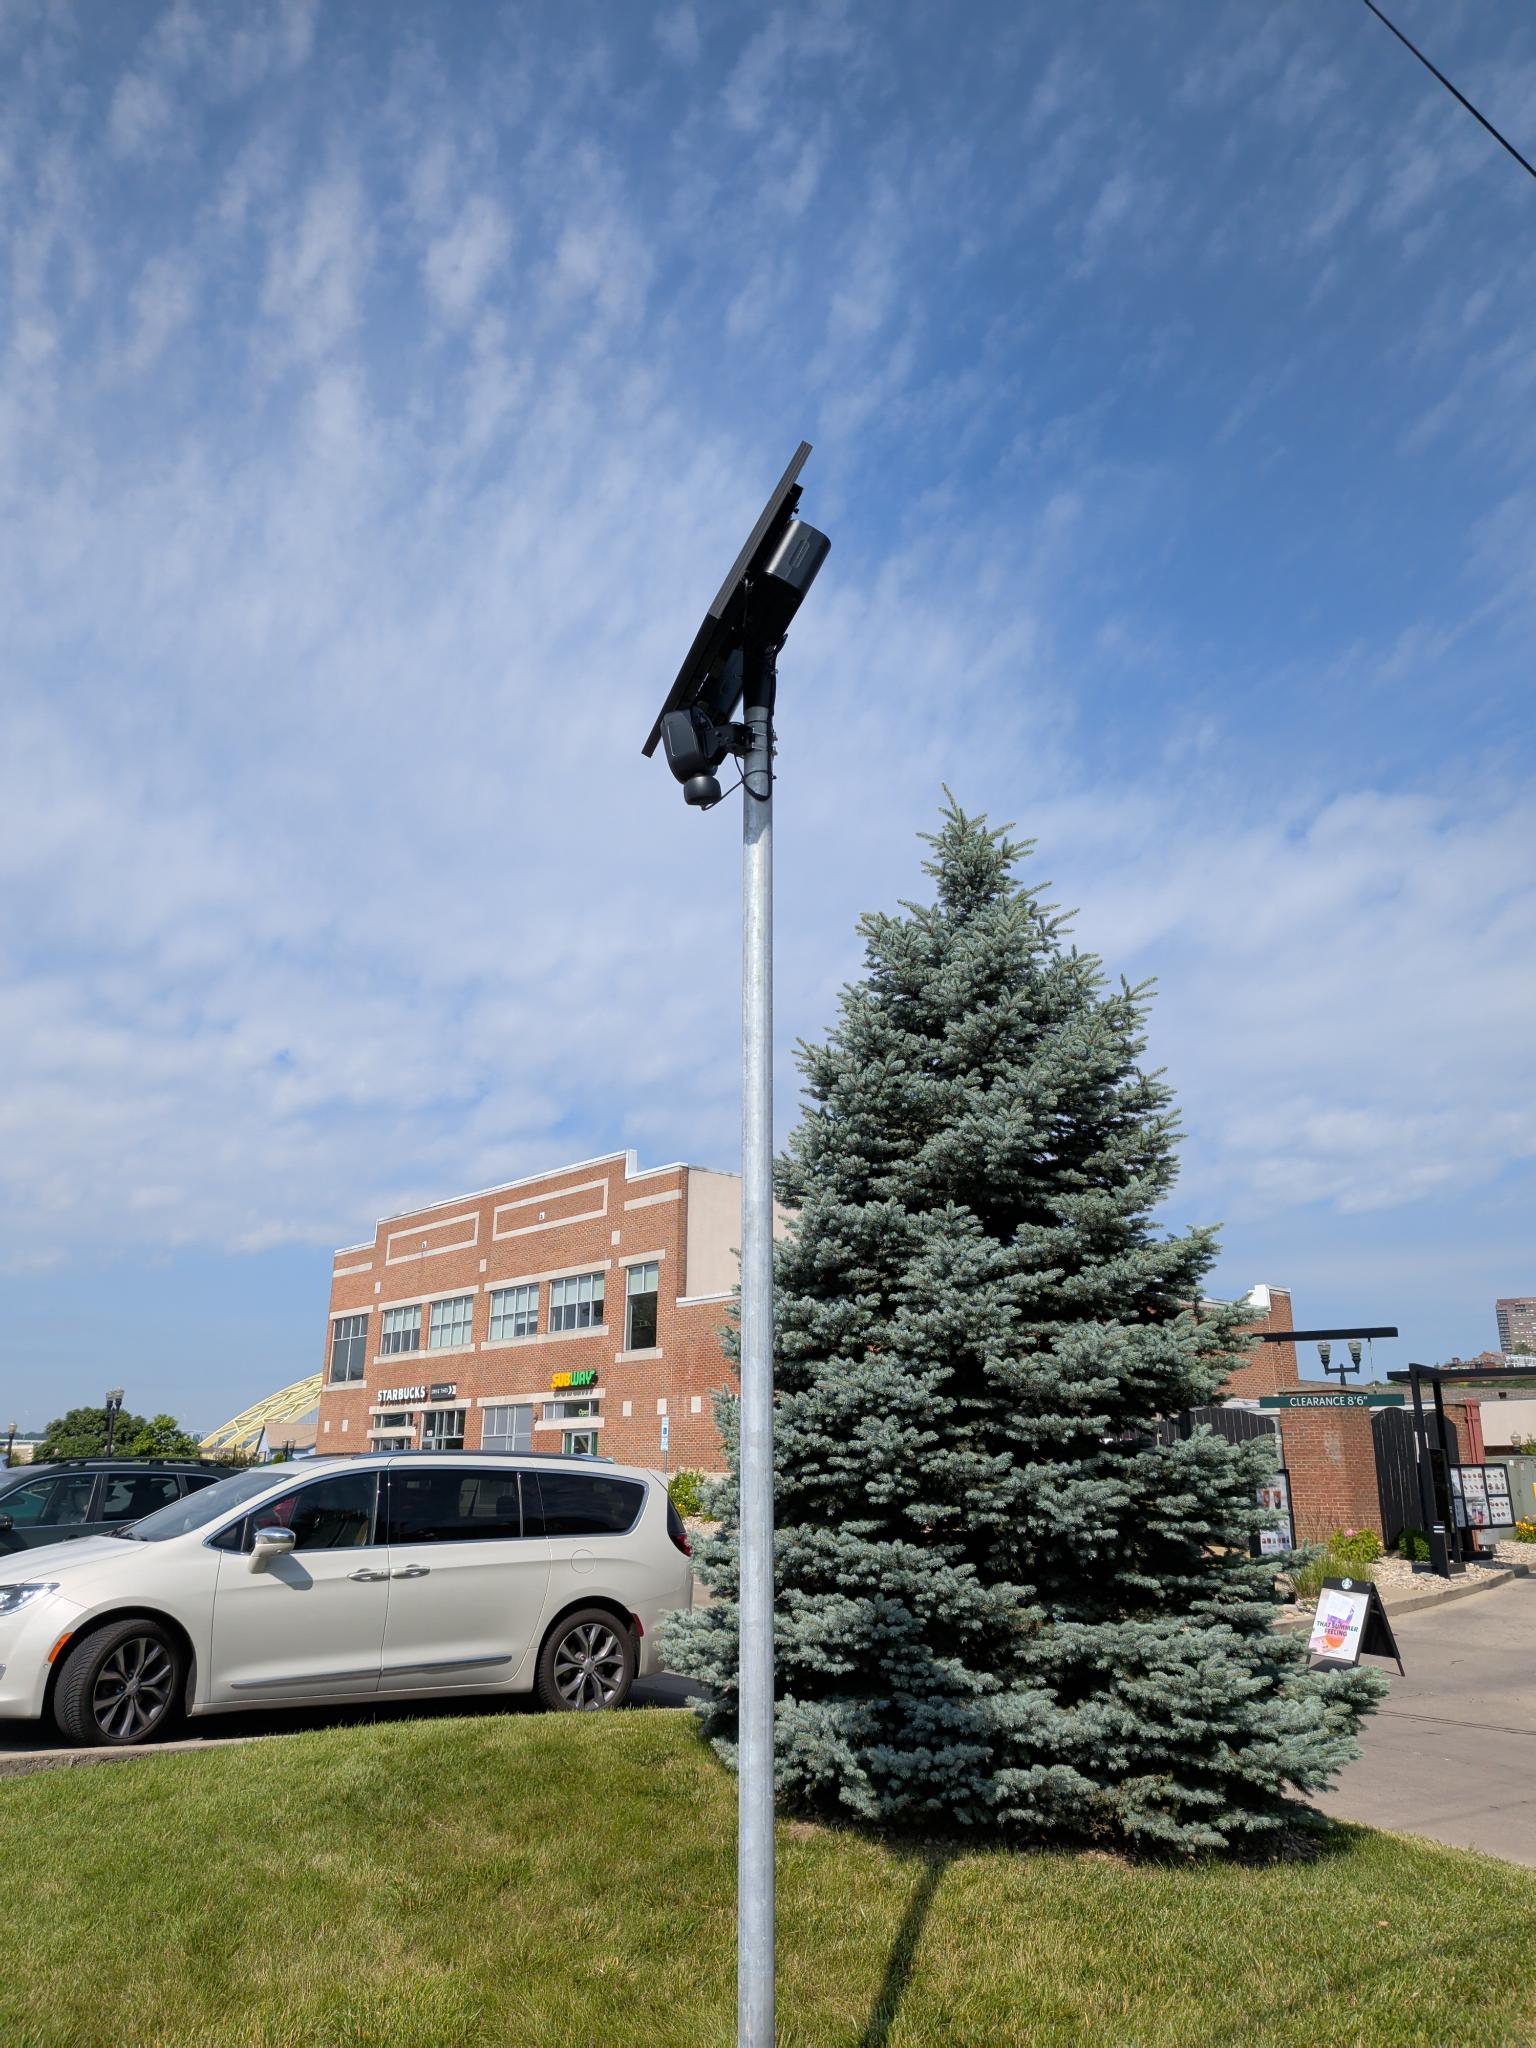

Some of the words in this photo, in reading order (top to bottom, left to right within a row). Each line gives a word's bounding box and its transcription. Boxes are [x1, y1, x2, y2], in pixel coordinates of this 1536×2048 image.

[551, 1370, 596, 1388] SUBWAY
[377, 1386, 426, 1401] STARBUCKS
[1289, 1396, 1346, 1407] CLEARANCE
[1325, 1628, 1347, 1636] FEELING
[1332, 1623, 1358, 1632] SUMMER
